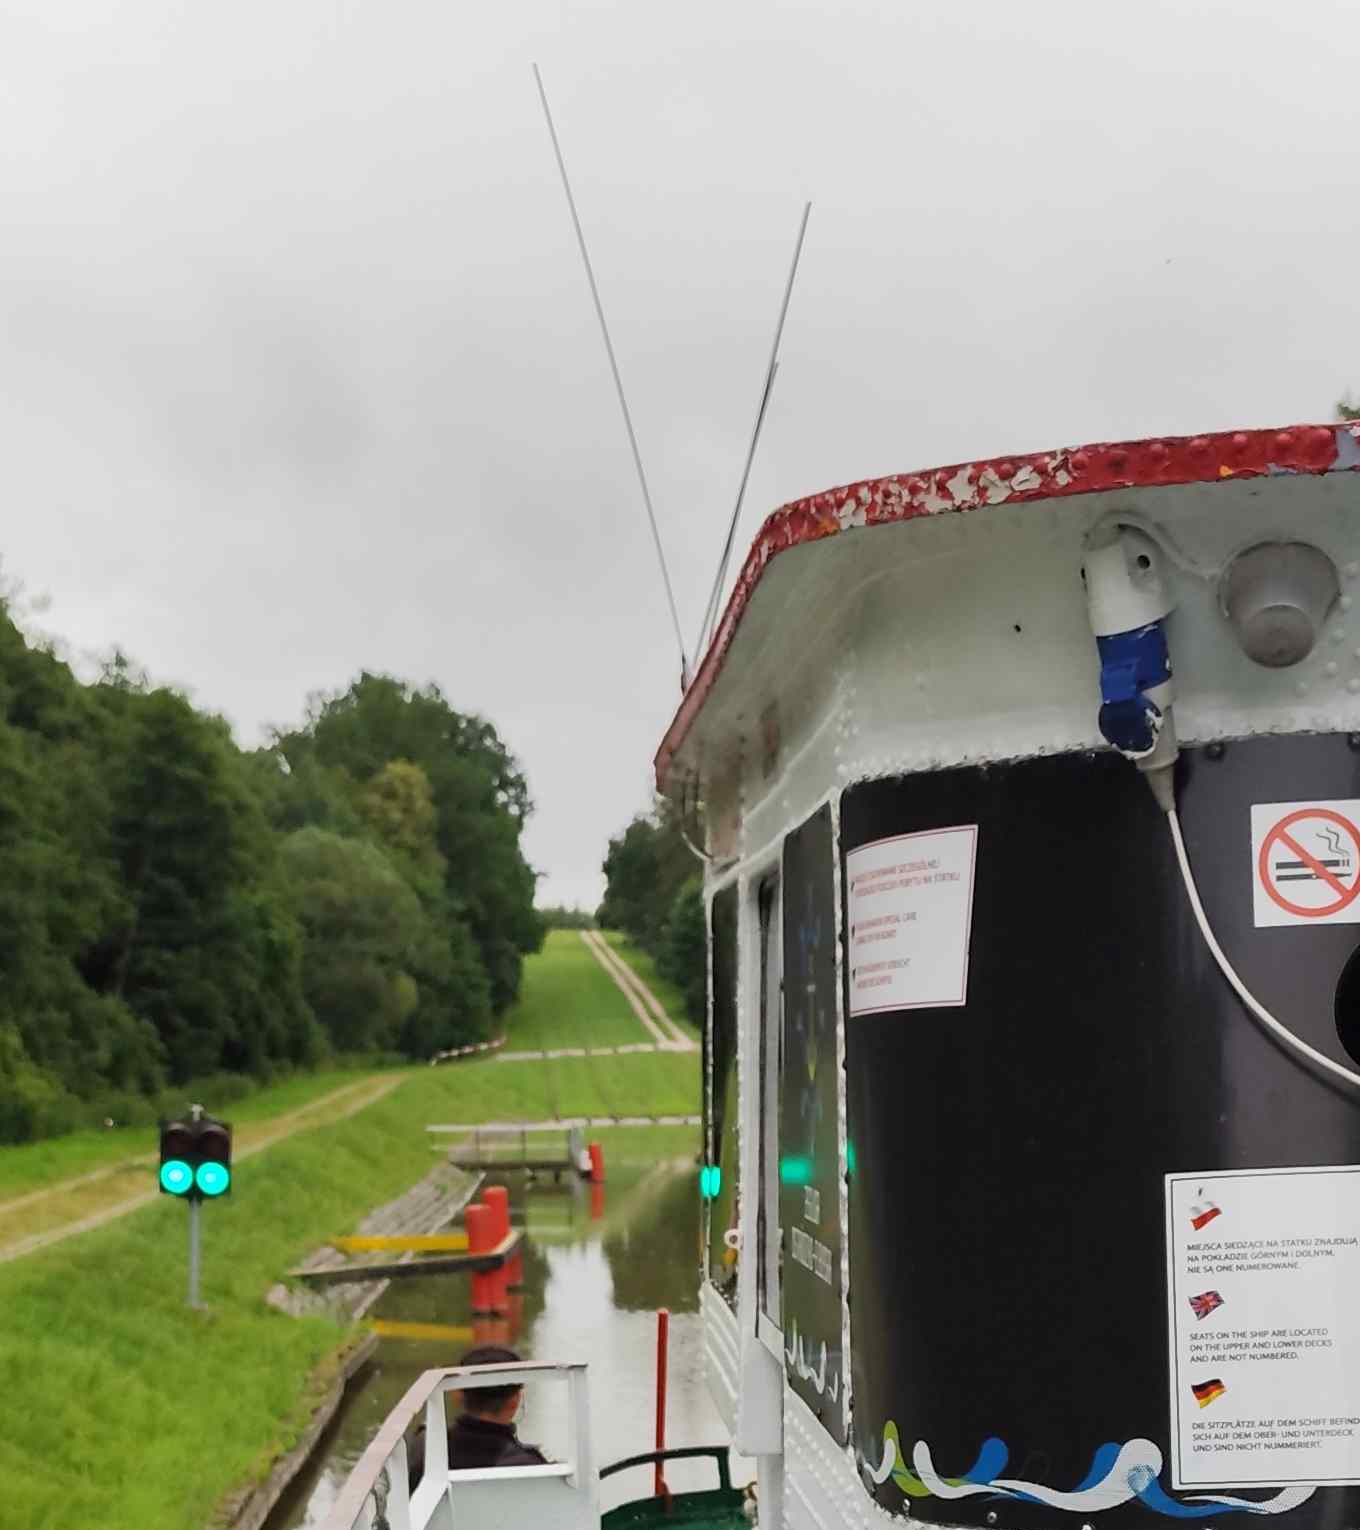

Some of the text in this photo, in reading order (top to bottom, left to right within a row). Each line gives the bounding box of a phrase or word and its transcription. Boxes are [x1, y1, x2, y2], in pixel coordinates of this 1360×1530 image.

[1187, 1243, 1222, 1251] MIEJSCA
[1267, 1240, 1278, 1248] NA
[1281, 1239, 1312, 1247] STATKU
[1216, 1264, 1234, 1272] ONE
[1190, 1328, 1328, 1340] SEATS ON THE SHIP ARE LOCATED
[1190, 1344, 1202, 1352] ON
[1205, 1343, 1220, 1352] THE
[1222, 1342, 1250, 1350] UPPER
[1252, 1341, 1271, 1349] AND
[1273, 1340, 1303, 1349] LOWER
[1190, 1355, 1208, 1363] AND
[1211, 1354, 1227, 1362] ARE
[1229, 1353, 1246, 1361] NOT
[1192, 1422, 1205, 1430] DIE
[1258, 1420, 1274, 1428] AUF
[1277, 1419, 1297, 1427] DEM
[1192, 1433, 1211, 1441] SICH
[1214, 1432, 1229, 1440] AUF
[1232, 1432, 1251, 1440] DEM
[1281, 1430, 1301, 1438] UND
[1193, 1444, 1212, 1452] UND
[1214, 1443, 1234, 1451] SIND
[1236, 1442, 1261, 1451] NICHT
